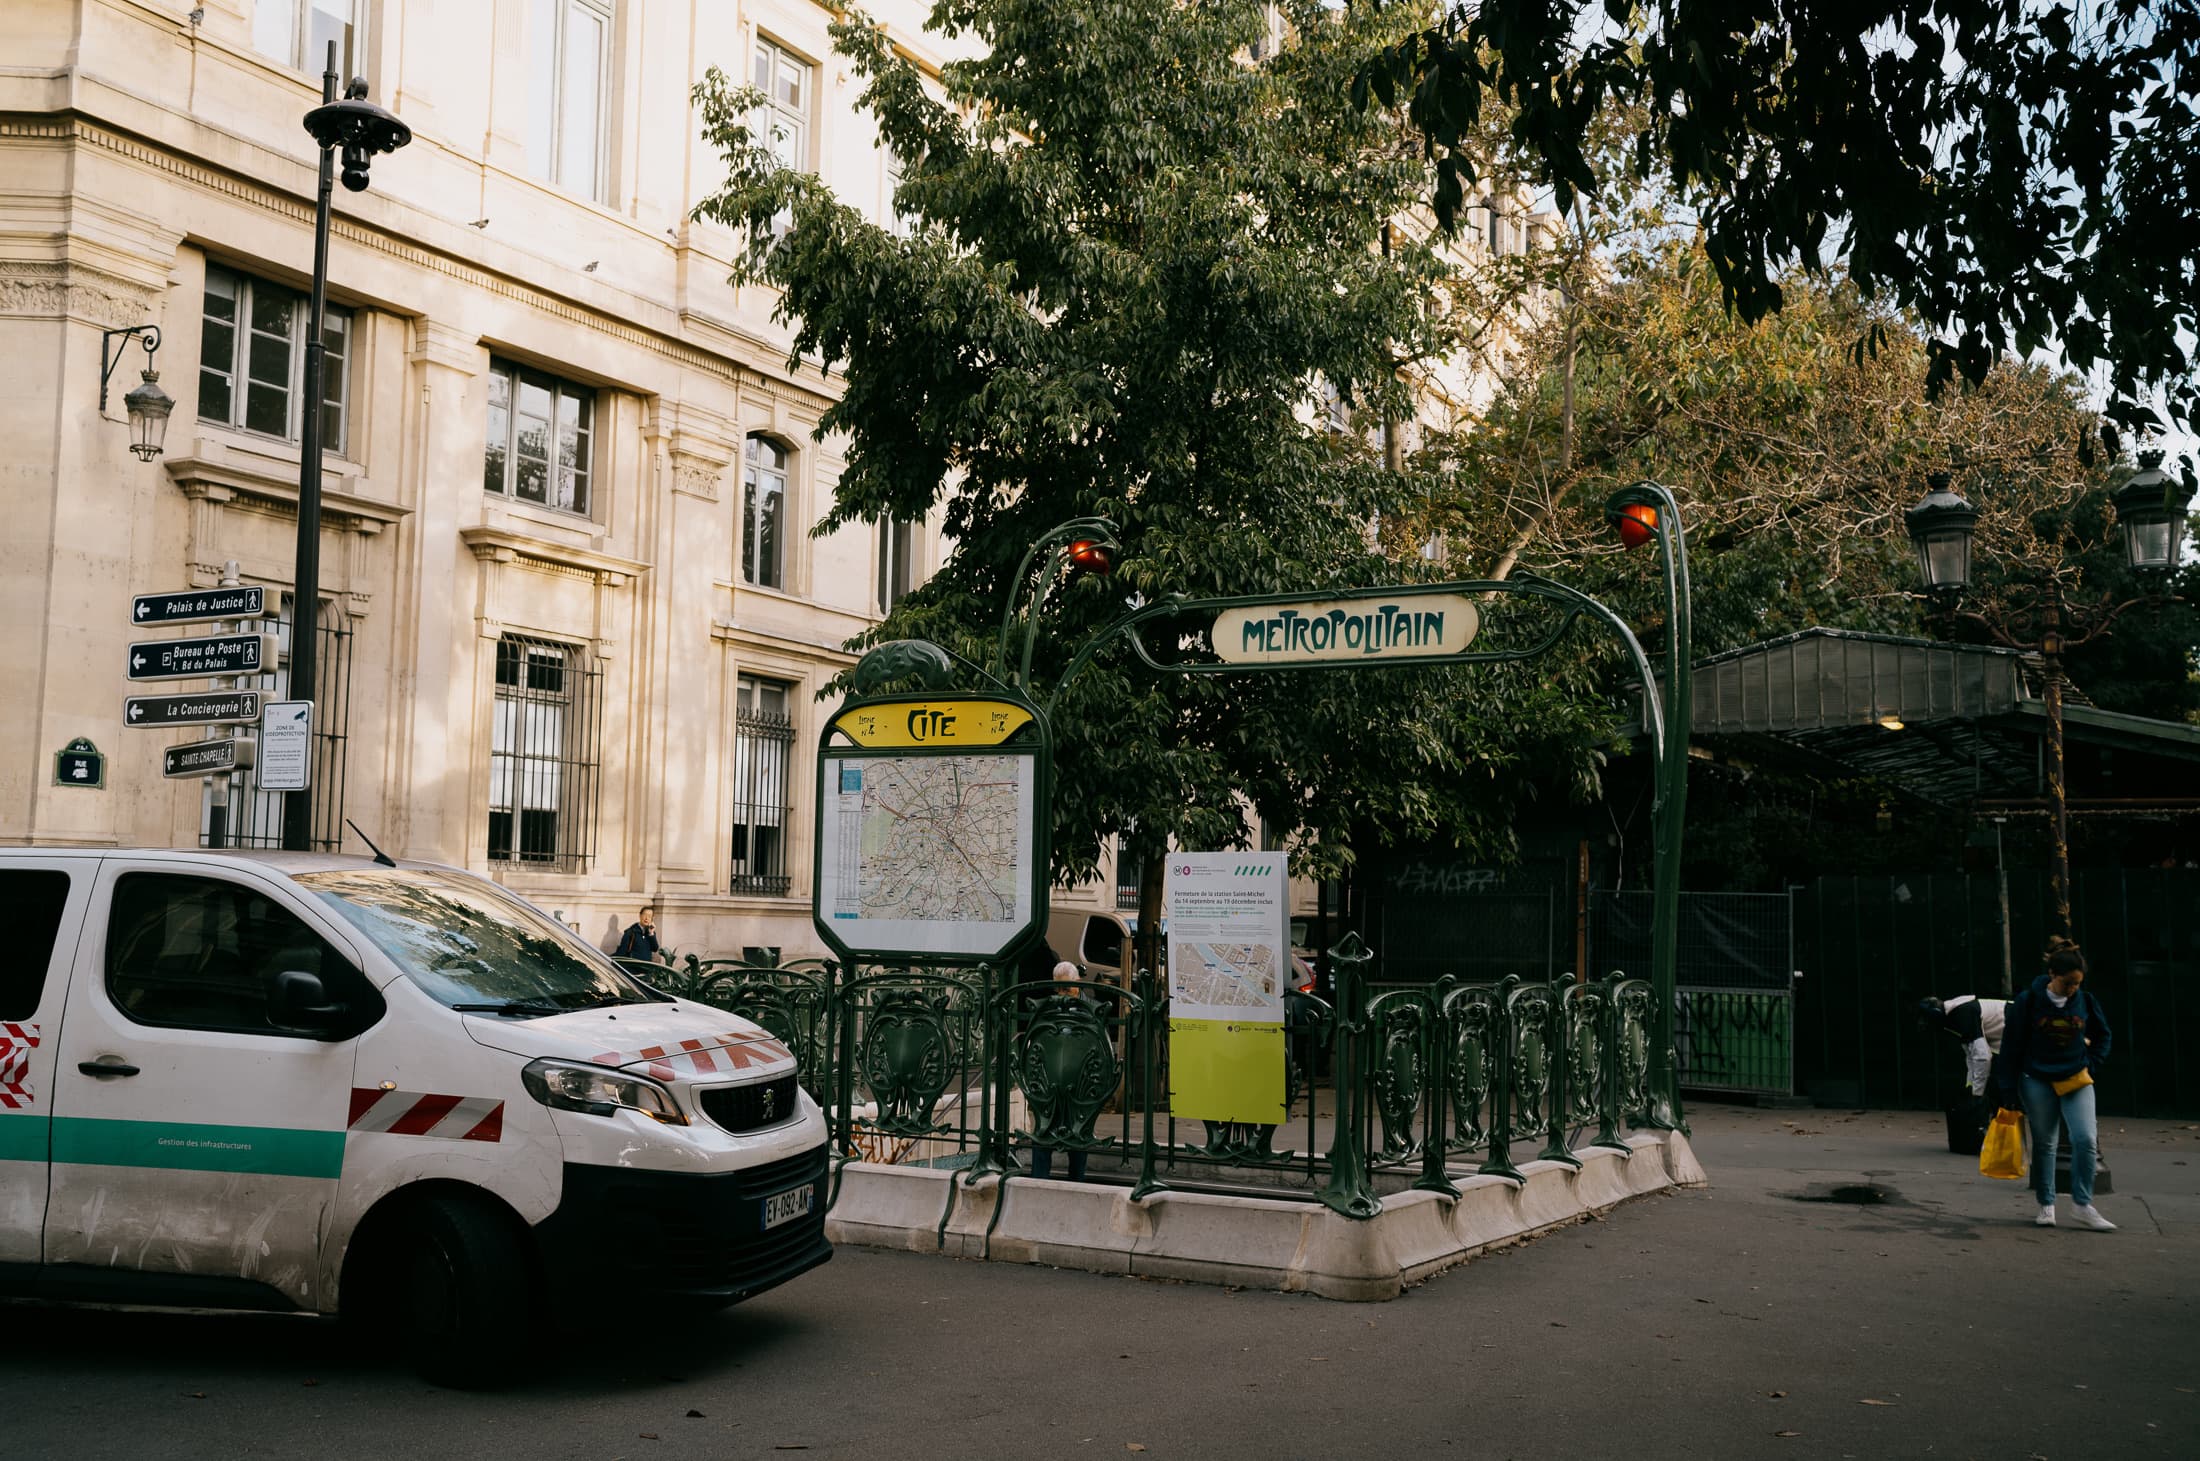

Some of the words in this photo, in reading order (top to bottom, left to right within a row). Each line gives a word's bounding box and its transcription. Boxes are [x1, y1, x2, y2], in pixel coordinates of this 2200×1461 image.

[166, 600, 193, 614] Palais
[196, 599, 207, 611] de
[210, 596, 244, 610] Justice
[1242, 605, 1445, 654] METROPOLITAIN
[173, 646, 203, 658] Bureau
[204, 643, 215, 656] de
[217, 642, 242, 655] Poste
[181, 660, 192, 670] Bd
[193, 659, 203, 670] du
[204, 657, 228, 669] Palais
[167, 703, 178, 716] La
[180, 700, 239, 717] Conciergerie
[180, 752, 199, 766] SAINTE
[199, 748, 225, 763] CHAPELLE
[158, 1137, 185, 1147] Gestion
[186, 1138, 198, 1147] des
[200, 1139, 252, 1151] infrastructures
